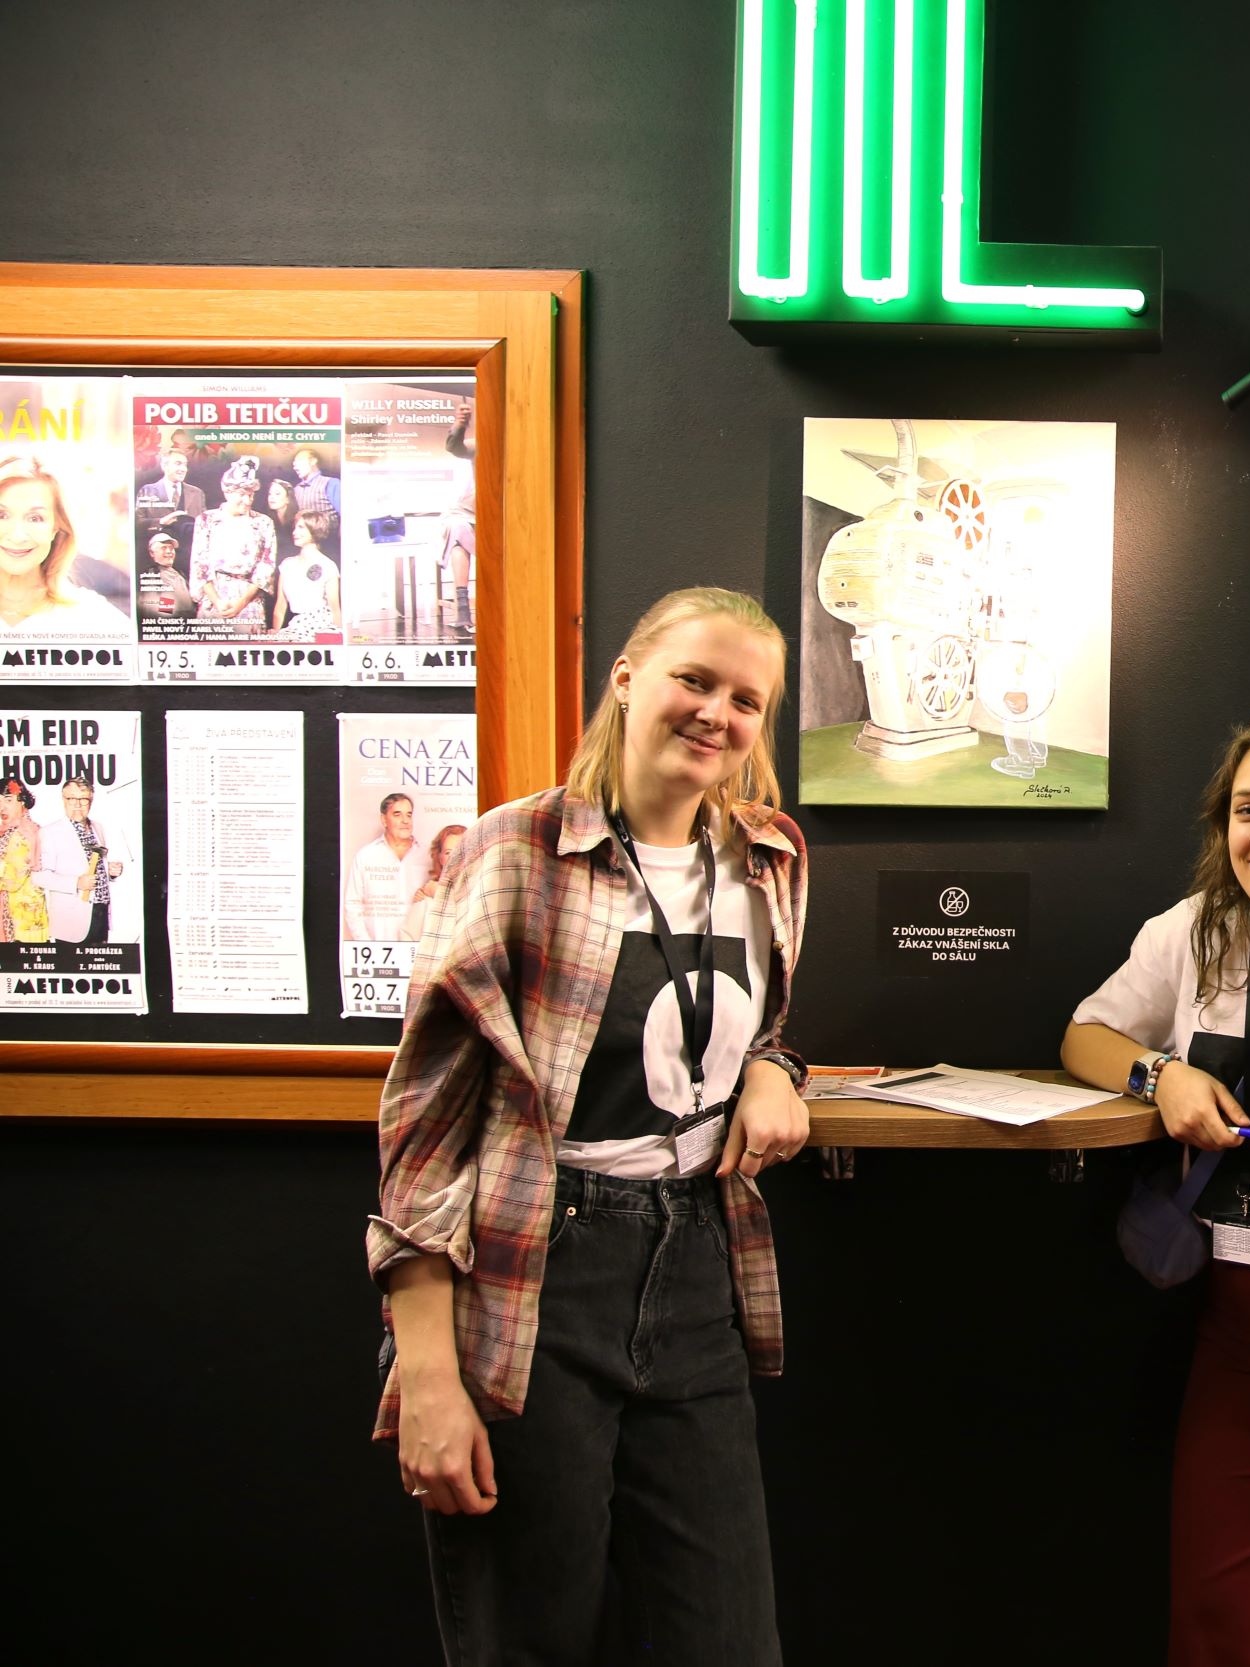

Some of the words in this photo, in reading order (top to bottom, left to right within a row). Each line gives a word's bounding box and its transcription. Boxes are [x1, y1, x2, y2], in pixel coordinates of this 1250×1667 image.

[145, 402, 219, 424] POLIB
[226, 397, 328, 424] TETIČKU
[351, 399, 394, 411] WILLY
[396, 399, 455, 410] RUSSELL
[351, 414, 394, 426] Shirley
[396, 413, 455, 424] Valentine
[194, 433, 218, 441] aneb
[219, 433, 250, 441] NIKDO
[252, 431, 275, 441] NENÍ
[277, 433, 293, 441] BEZ
[295, 433, 326, 441] CHYBY
[157, 617, 185, 626] ČENSKÝ,
[164, 625, 184, 633] NOVÝ
[2, 649, 123, 667] METROPOL
[148, 650, 171, 668] 19.
[179, 650, 194, 668] 5.
[215, 649, 334, 667] METROPOL
[362, 651, 378, 669] 6.
[385, 651, 401, 669] 6.
[359, 738, 431, 759] CENA
[438, 739, 470, 760] ZA
[2, 753, 116, 786] HODINU
[892, 927, 899, 936] Z
[901, 924, 945, 936] DŮVODU
[947, 925, 1016, 937] BEZPEČNOSTI
[85, 947, 123, 955] PROCHÁZKA
[898, 938, 933, 949] ZÁKAZ
[935, 938, 981, 949] VNÁŠENÍ
[982, 941, 1010, 950] SKLA
[352, 947, 375, 964] 19.
[382, 947, 395, 964] 7.
[932, 952, 947, 961] DO
[949, 950, 976, 961] SÁLU
[14, 977, 132, 995] METROPOL
[352, 983, 380, 1001] 20.
[386, 984, 400, 1001] 7.
